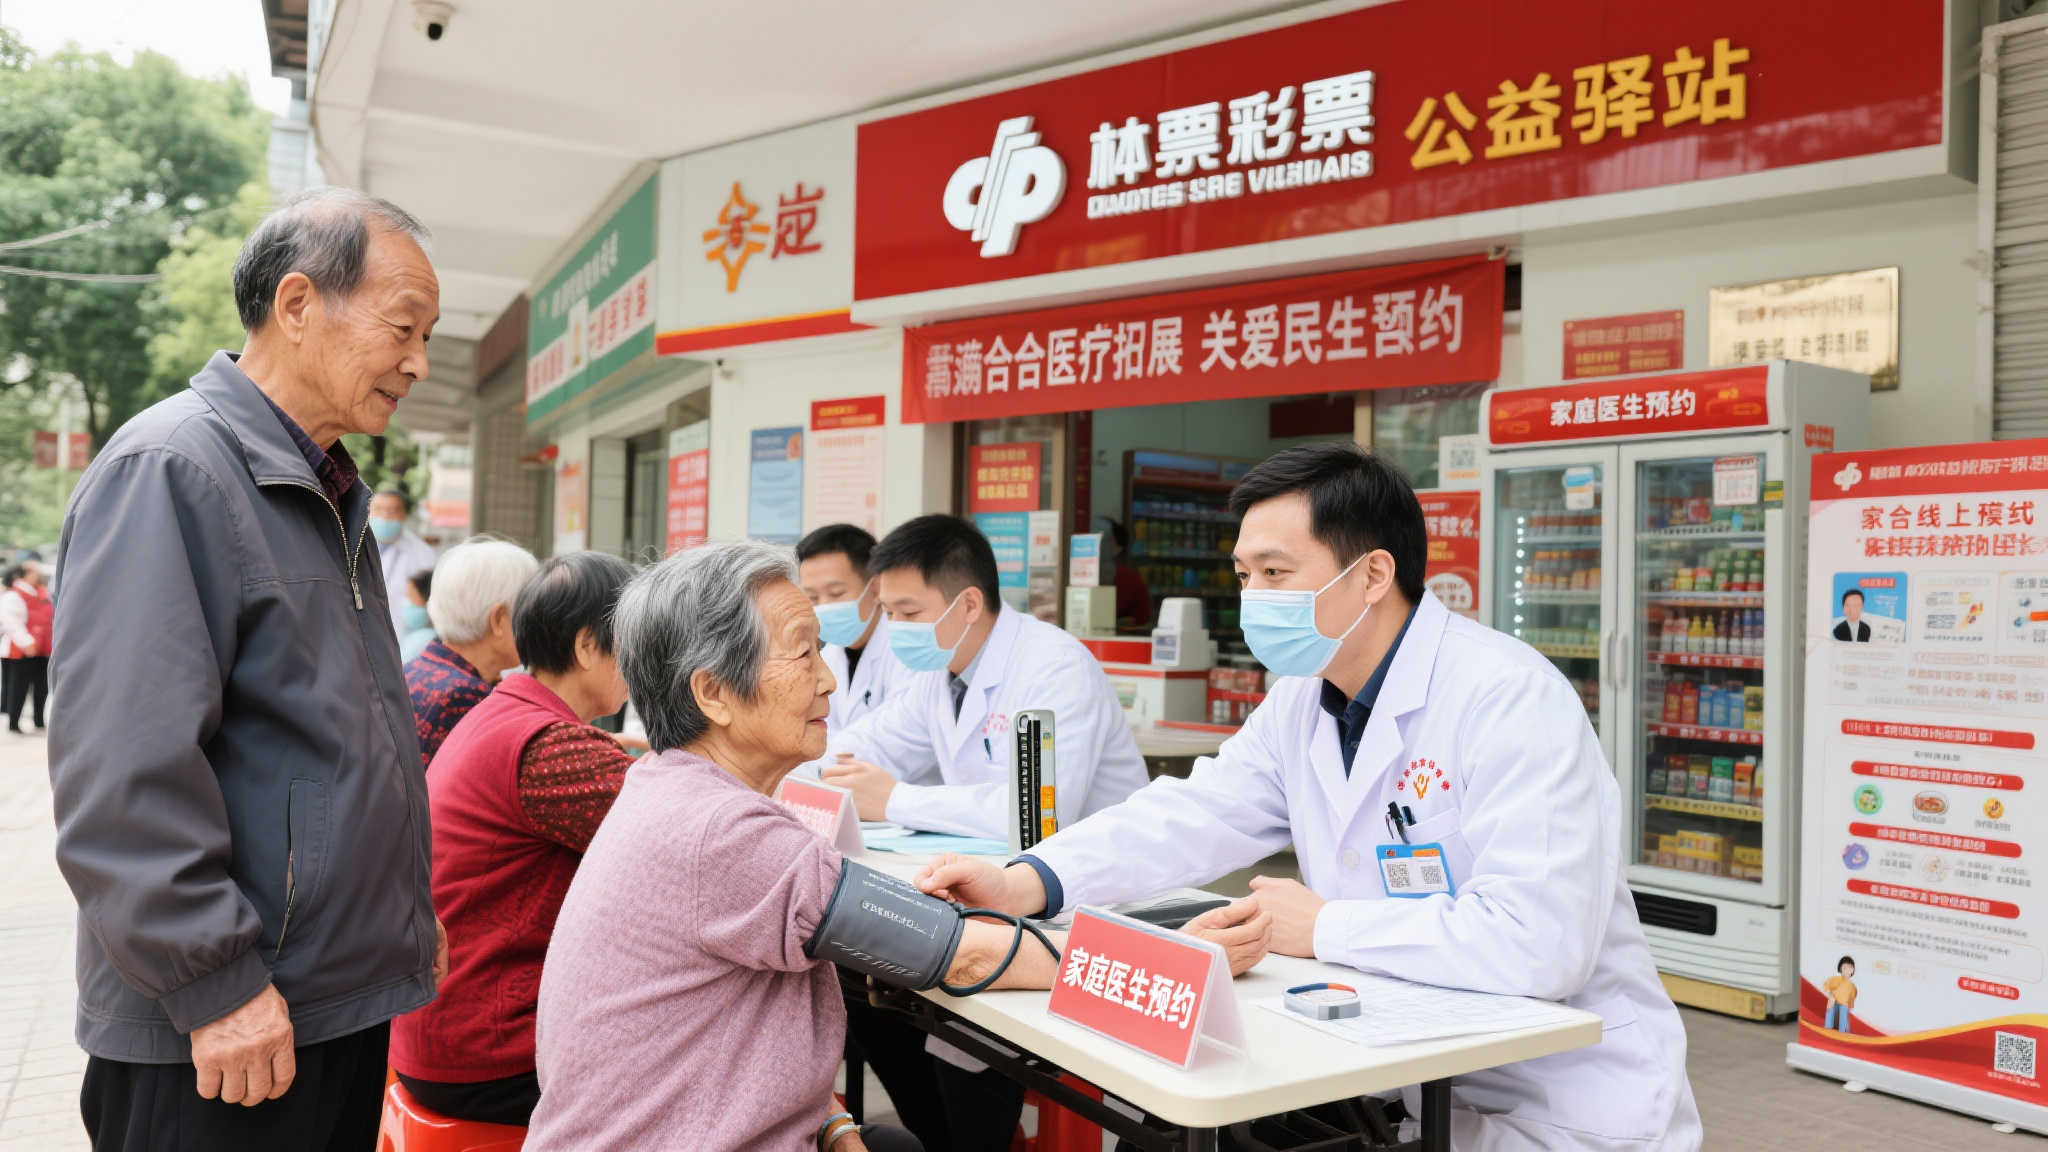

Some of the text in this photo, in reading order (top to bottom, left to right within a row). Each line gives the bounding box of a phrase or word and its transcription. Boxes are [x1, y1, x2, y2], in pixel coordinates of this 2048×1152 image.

[1404, 38, 1750, 170] 公益驿站
[1550, 388, 1697, 427] 家庭医生预约
[1062, 946, 1197, 1030] 家庭医生预约
